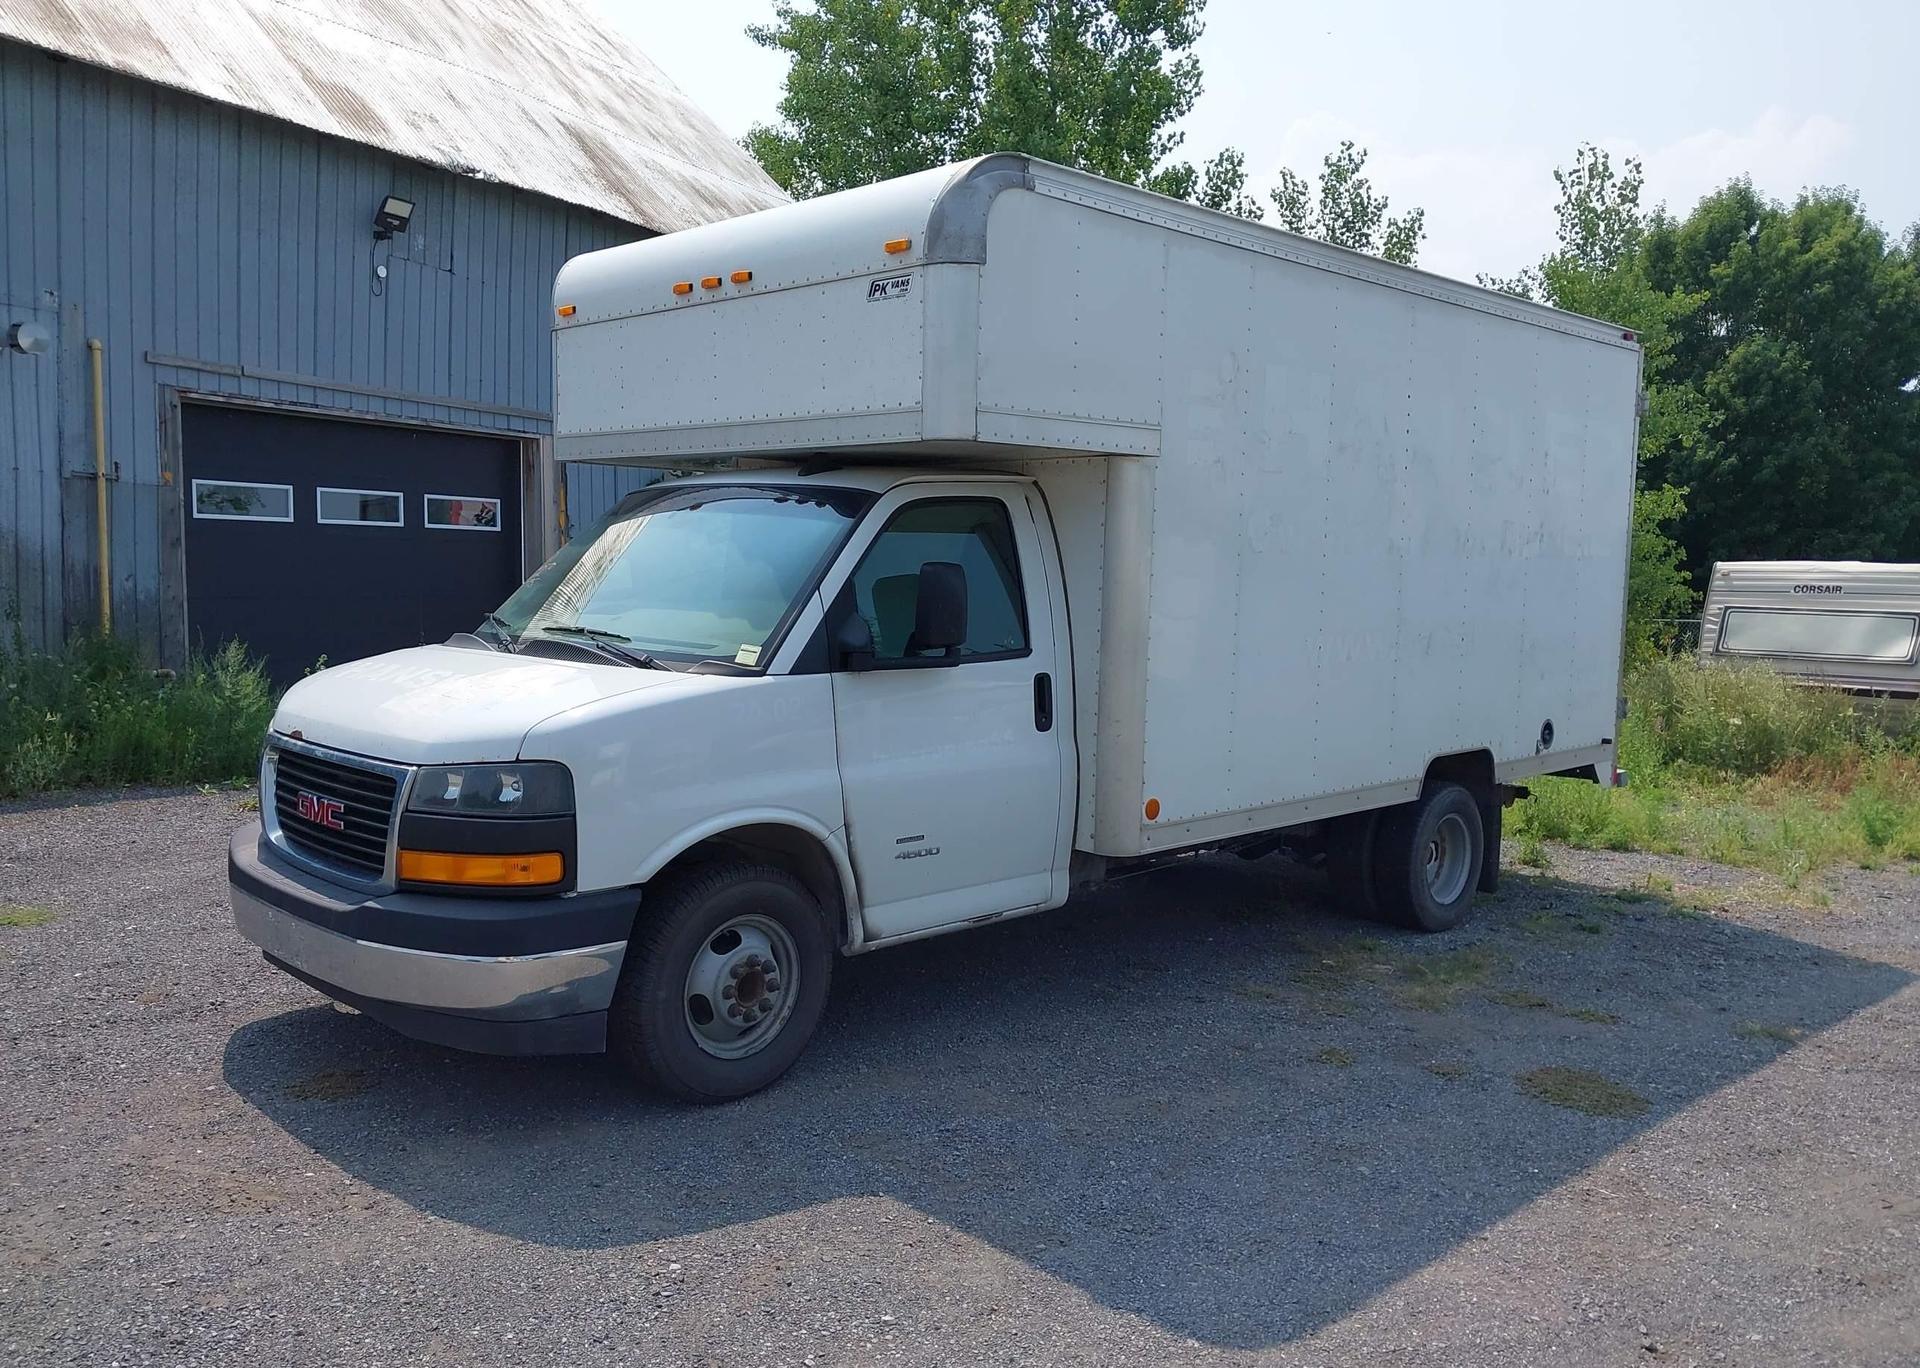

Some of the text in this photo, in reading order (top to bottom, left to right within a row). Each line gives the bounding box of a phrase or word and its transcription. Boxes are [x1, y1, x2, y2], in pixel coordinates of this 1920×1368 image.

[872, 278, 911, 297] PK VANS
[1793, 585, 1843, 595] CORSAIR
[297, 791, 344, 831] GMC
[894, 847, 941, 860] 4500
